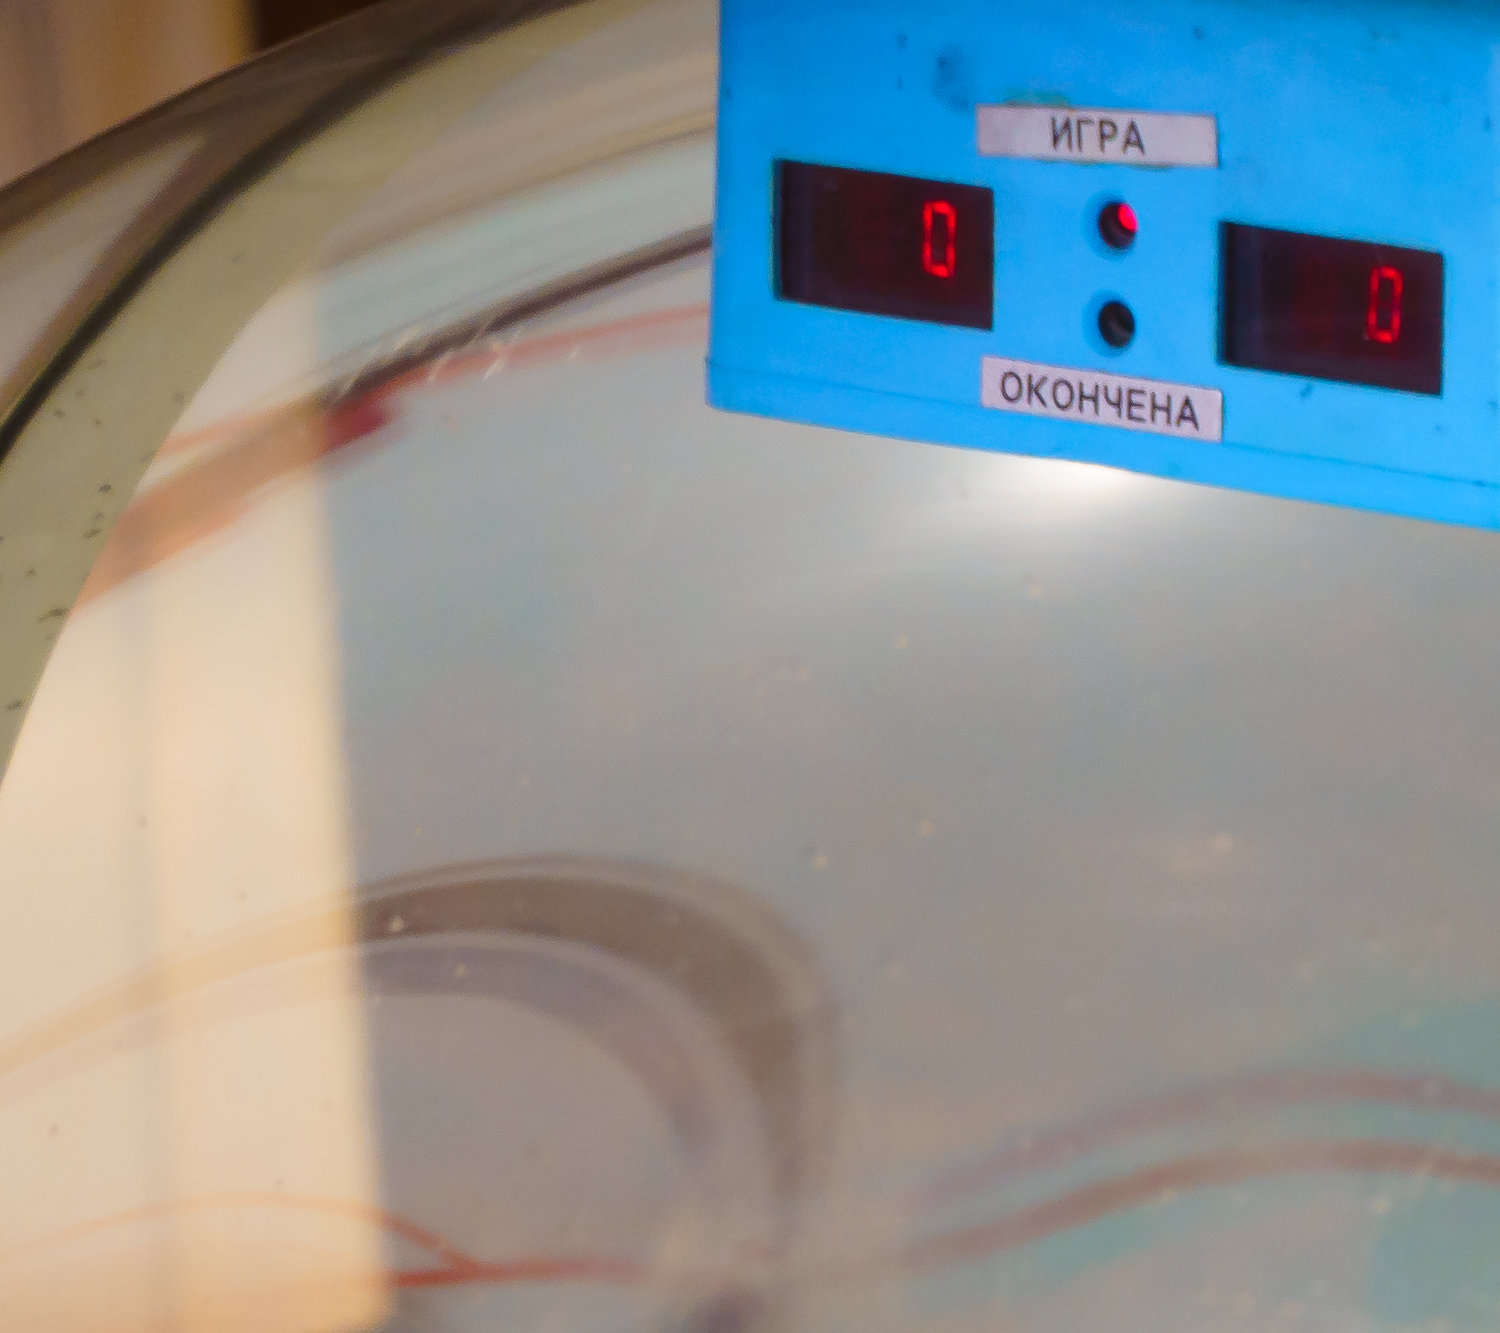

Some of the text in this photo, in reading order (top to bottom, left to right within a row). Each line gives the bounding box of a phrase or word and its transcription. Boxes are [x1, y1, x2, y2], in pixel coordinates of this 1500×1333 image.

[1049, 113, 1149, 157] ИГРА
[920, 199, 957, 279] 0
[1366, 264, 1404, 345] 0
[998, 370, 1202, 430] ОКОНЧЕНА
